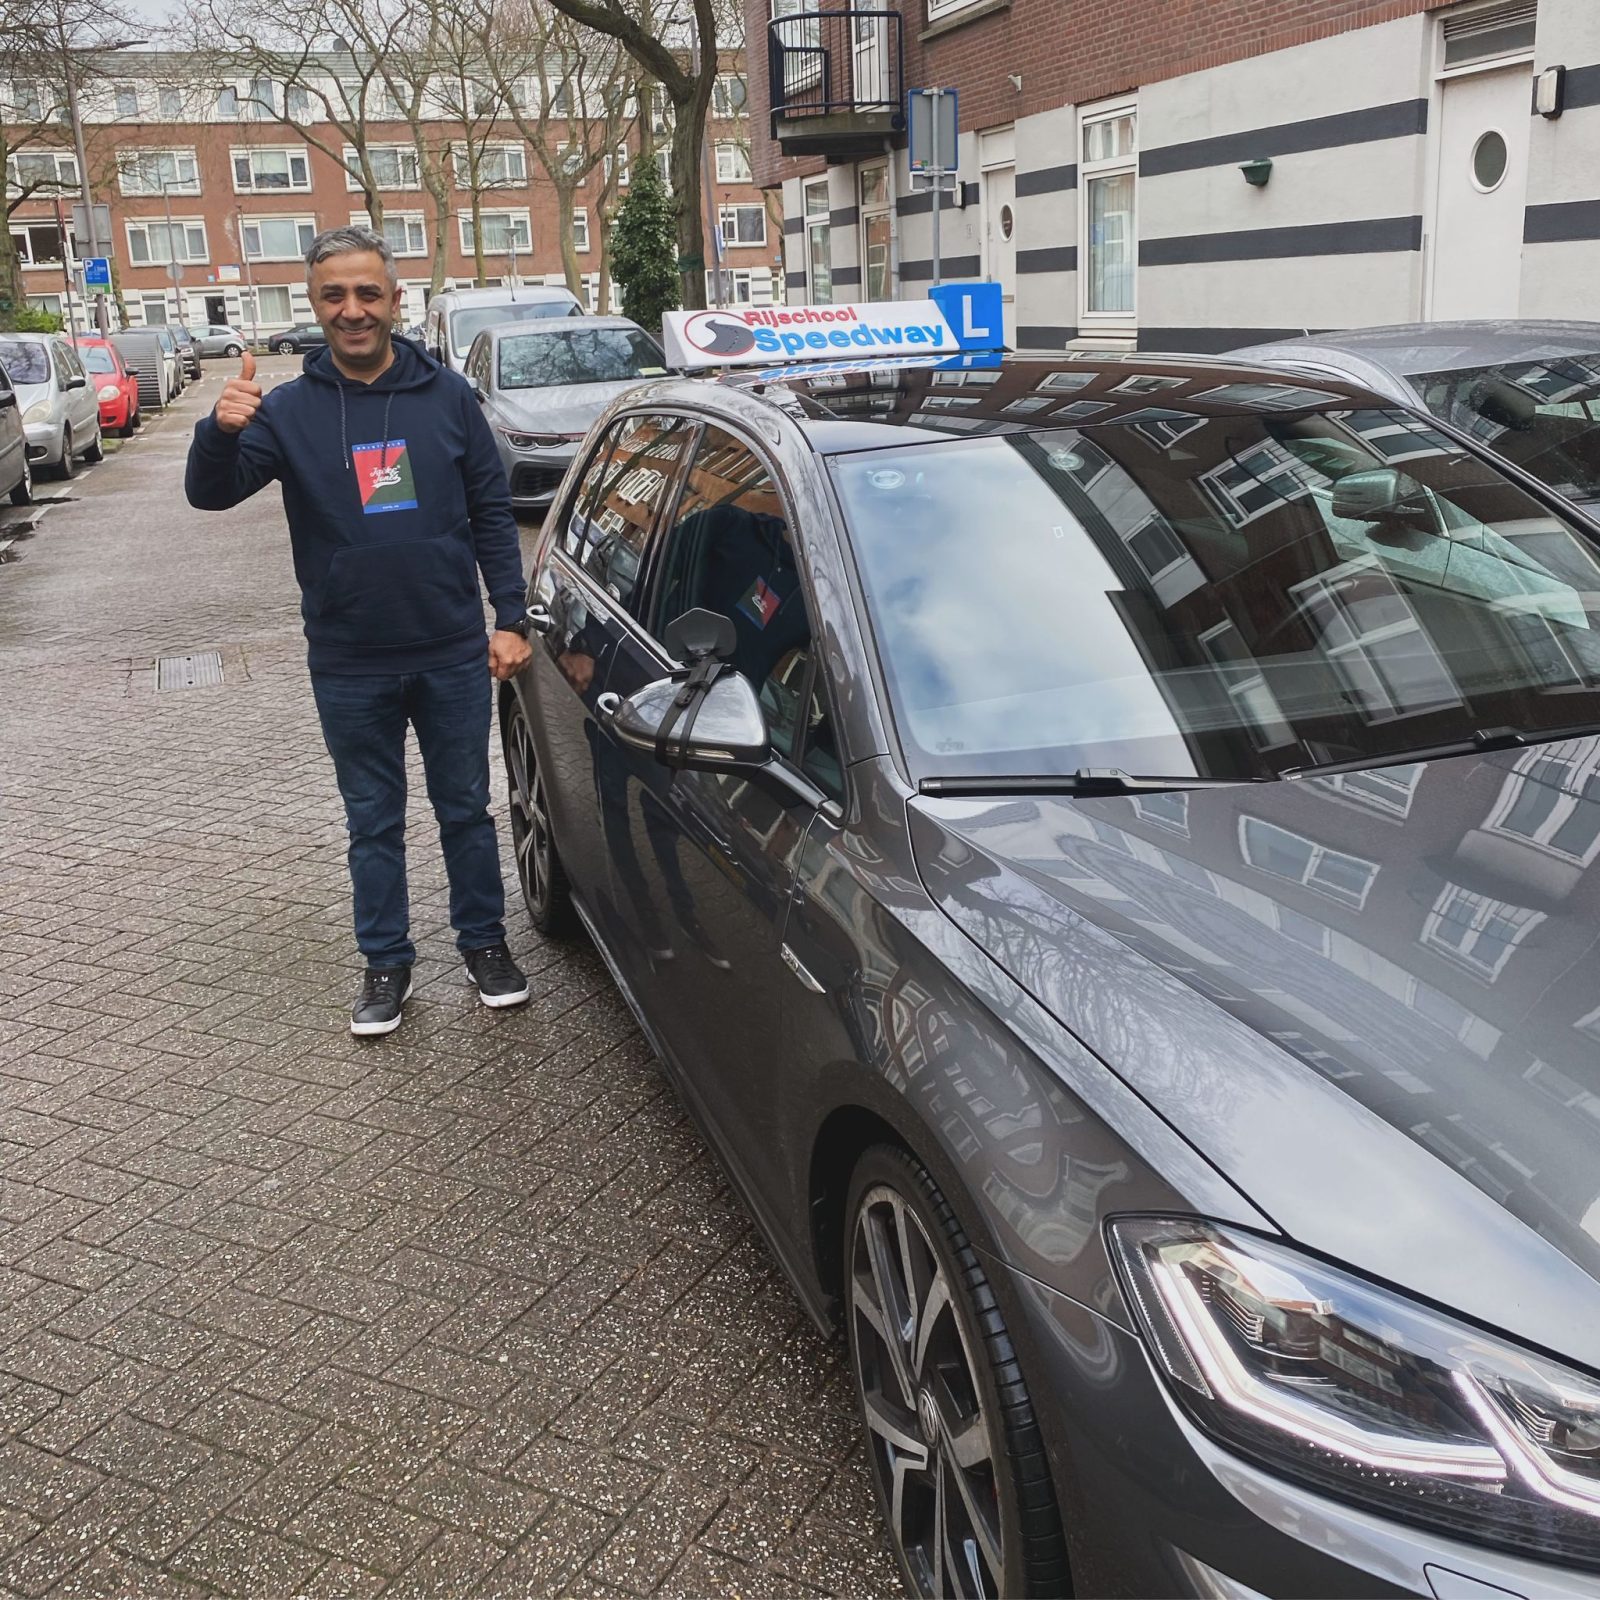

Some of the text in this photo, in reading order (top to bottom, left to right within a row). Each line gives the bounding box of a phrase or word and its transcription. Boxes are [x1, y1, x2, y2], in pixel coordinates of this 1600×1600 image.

[84, 259, 94, 273] P
[744, 307, 857, 327] Rijschool
[963, 294, 990, 337] L
[755, 324, 944, 355] Speedway
